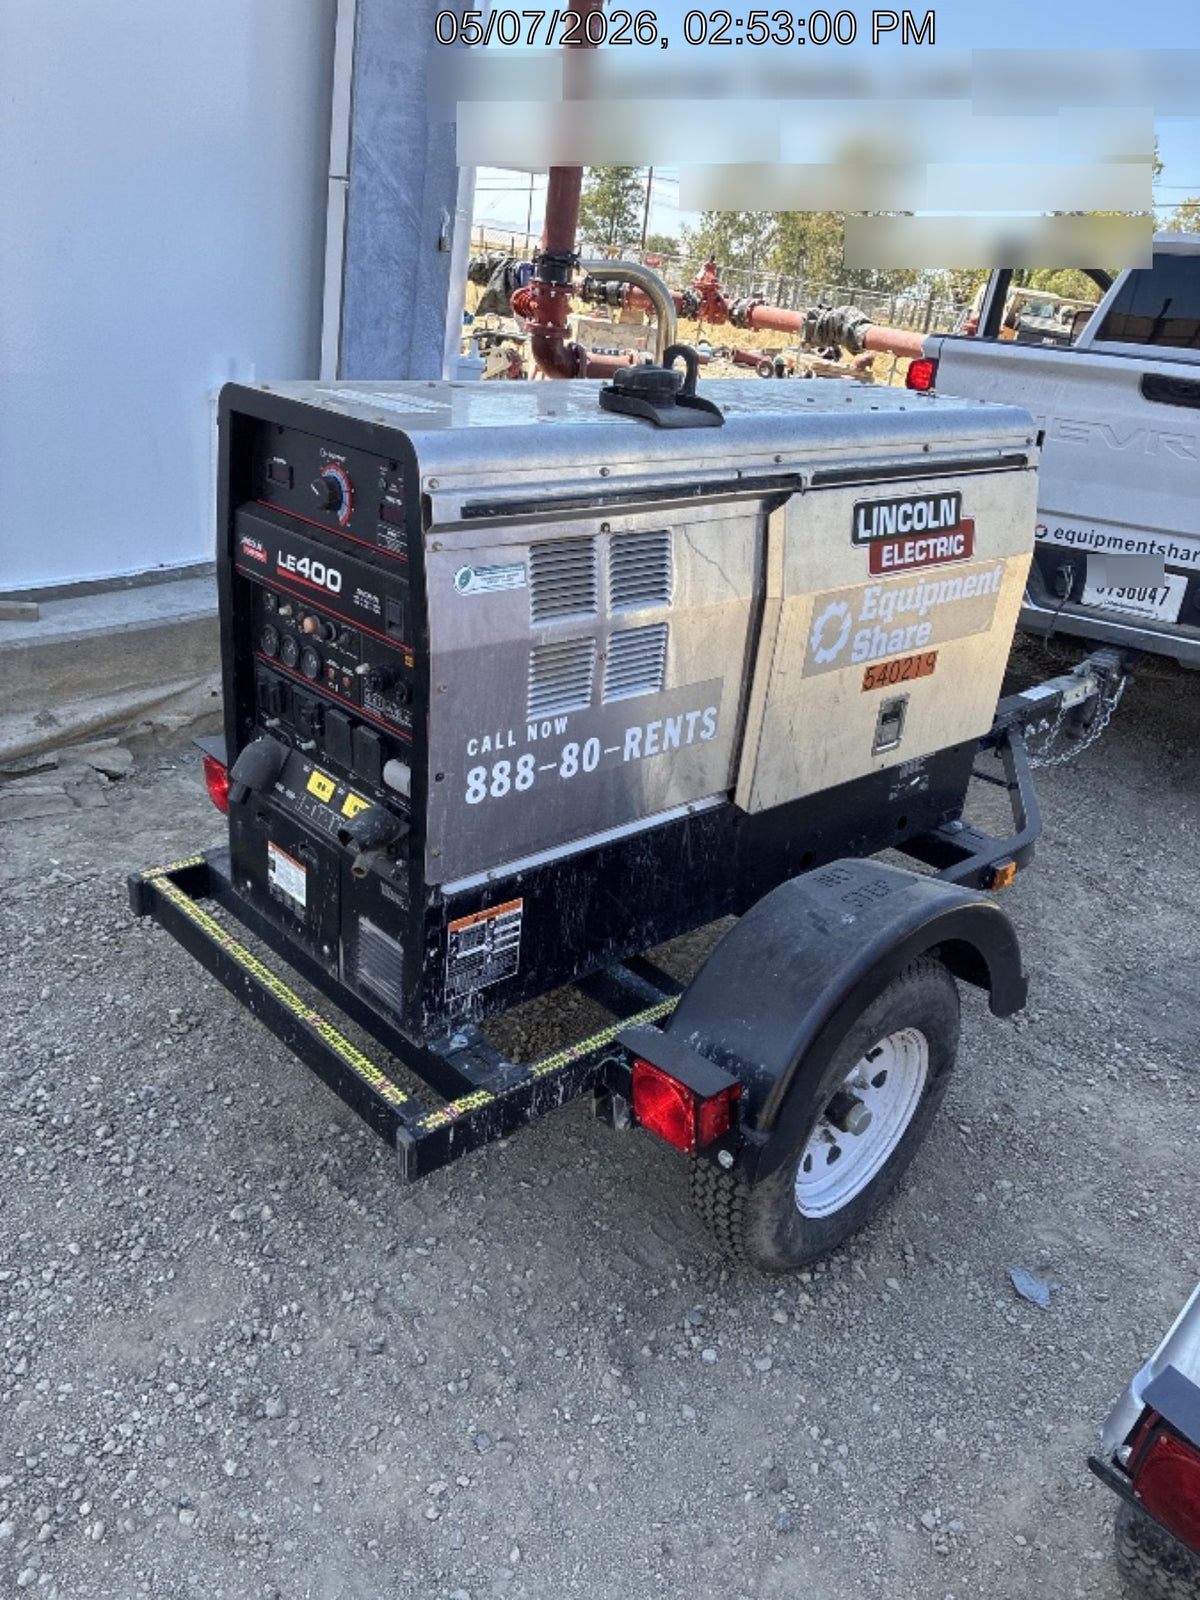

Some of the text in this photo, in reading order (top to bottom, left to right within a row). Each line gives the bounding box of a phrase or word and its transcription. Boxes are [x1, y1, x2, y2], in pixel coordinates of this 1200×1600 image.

[858, 497, 956, 539] LINCOLN
[277, 550, 342, 593] LE400
[881, 534, 965, 568] ELECTRIC
[858, 565, 1003, 624] Equipment
[851, 621, 933, 662] Share
[863, 652, 937, 690] 540219
[464, 706, 718, 805] 888-80-RENTS
[467, 716, 568, 757] CALL NOW
